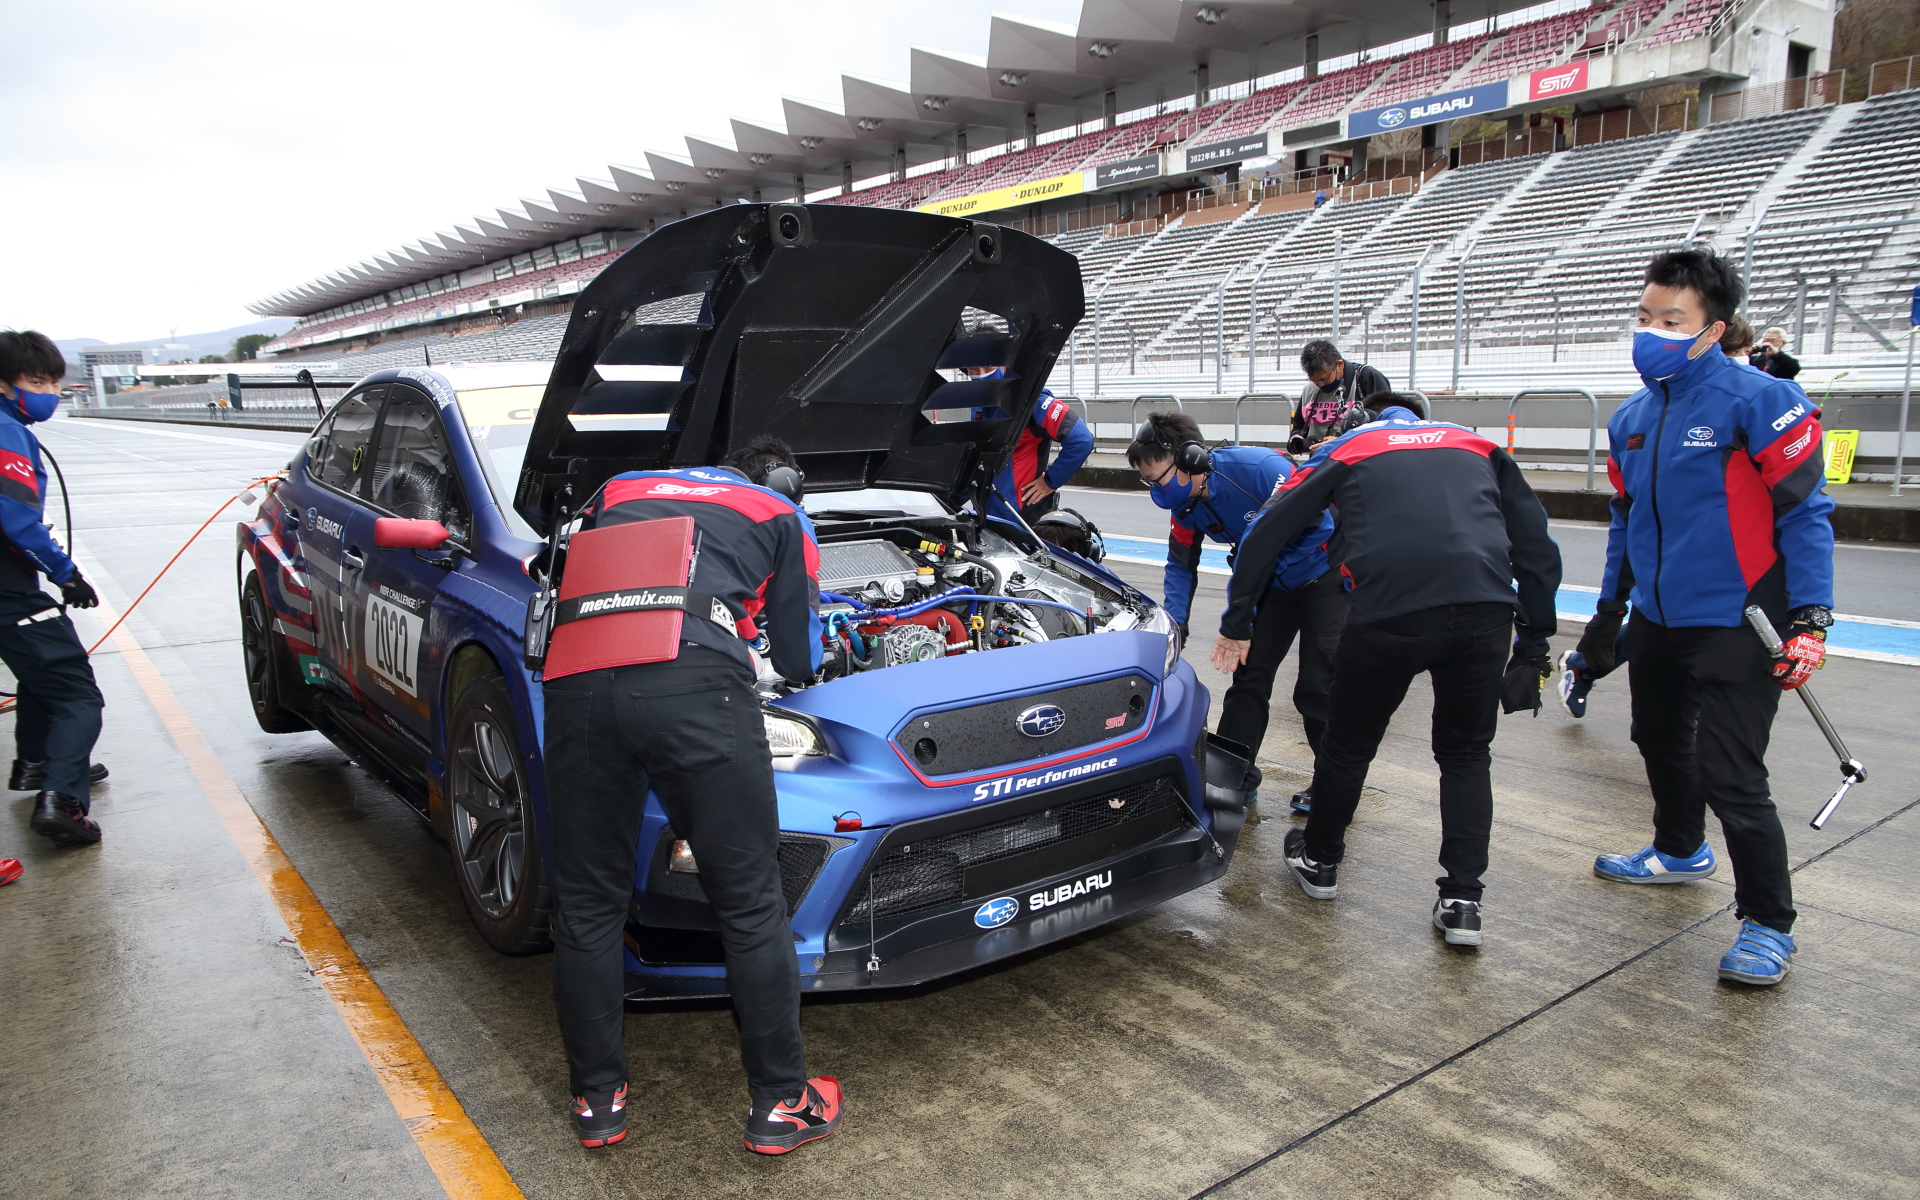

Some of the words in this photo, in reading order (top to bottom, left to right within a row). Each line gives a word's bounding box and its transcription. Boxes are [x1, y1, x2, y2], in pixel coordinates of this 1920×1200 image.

[1410, 96, 1474, 119] SUBARU
[1107, 165, 1144, 180] Speedway
[1018, 182, 1064, 199] DUNLOP
[940, 200, 978, 215] DUNLOP
[1771, 402, 1806, 432] CREW
[316, 515, 344, 540] SUBARU
[380, 584, 390, 597] NBR
[389, 588, 417, 610] CHALLENGE
[579, 590, 684, 614] mechanix.com
[371, 601, 414, 689] 2022
[379, 679, 396, 696] SUBARU
[973, 777, 1014, 801] STI
[1015, 757, 1118, 791] Performance
[1029, 870, 1113, 912] SUBARU
